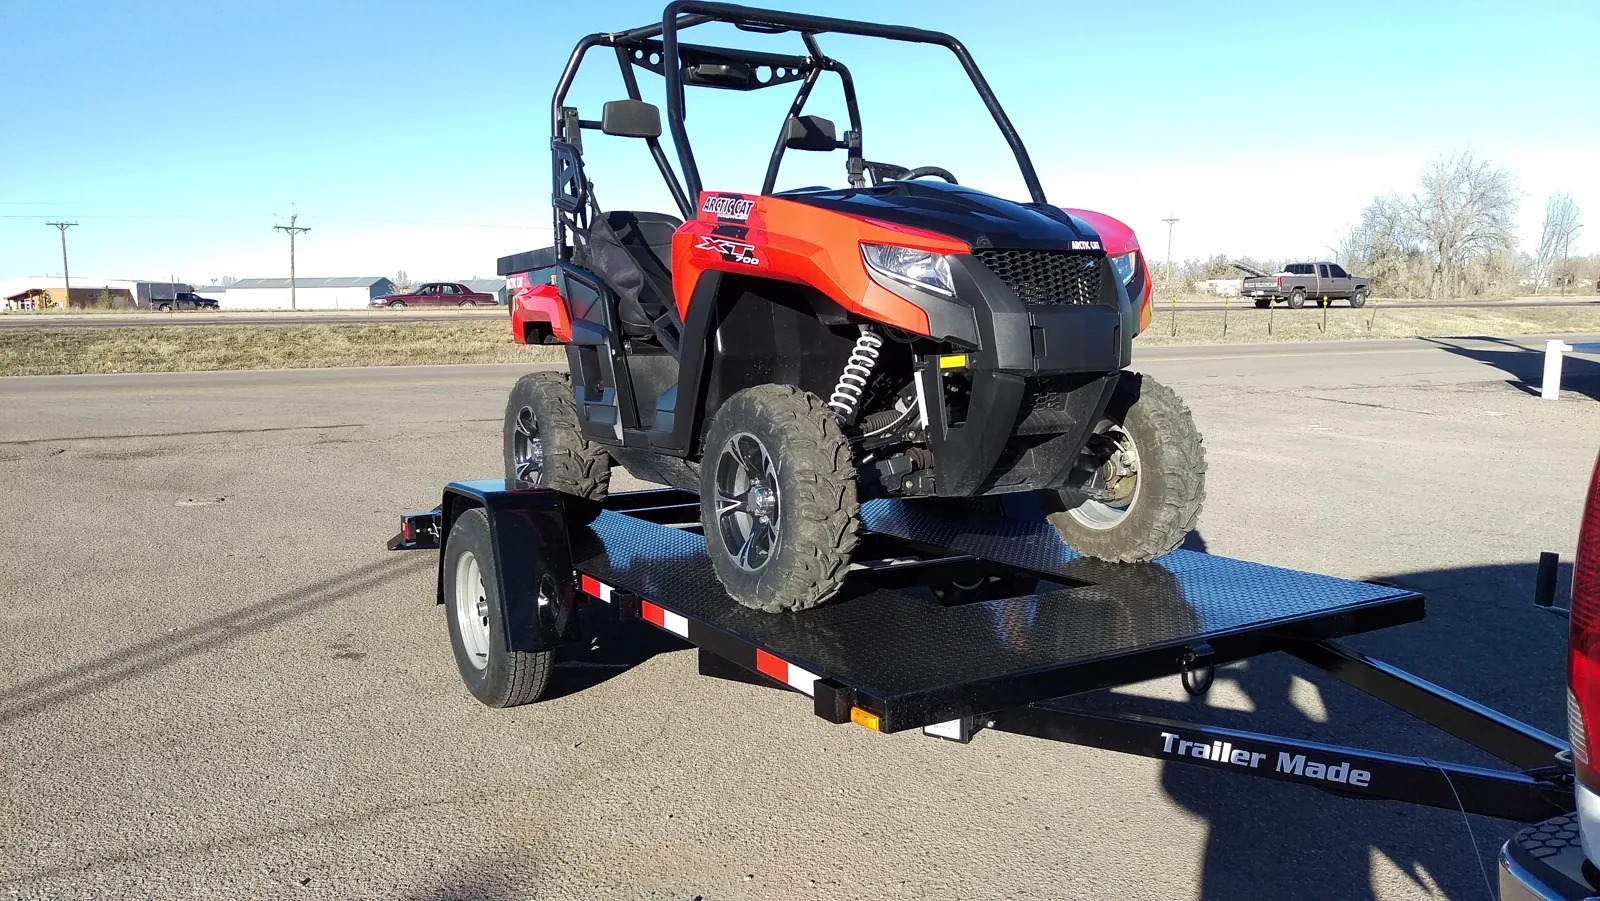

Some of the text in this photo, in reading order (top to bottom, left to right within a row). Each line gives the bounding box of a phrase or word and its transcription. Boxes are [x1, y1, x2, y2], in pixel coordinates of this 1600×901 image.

[702, 196, 755, 216] ARCTIC CAT
[694, 235, 755, 256] XT
[735, 255, 760, 265] 700
[1161, 731, 1371, 787] Trailer Made
